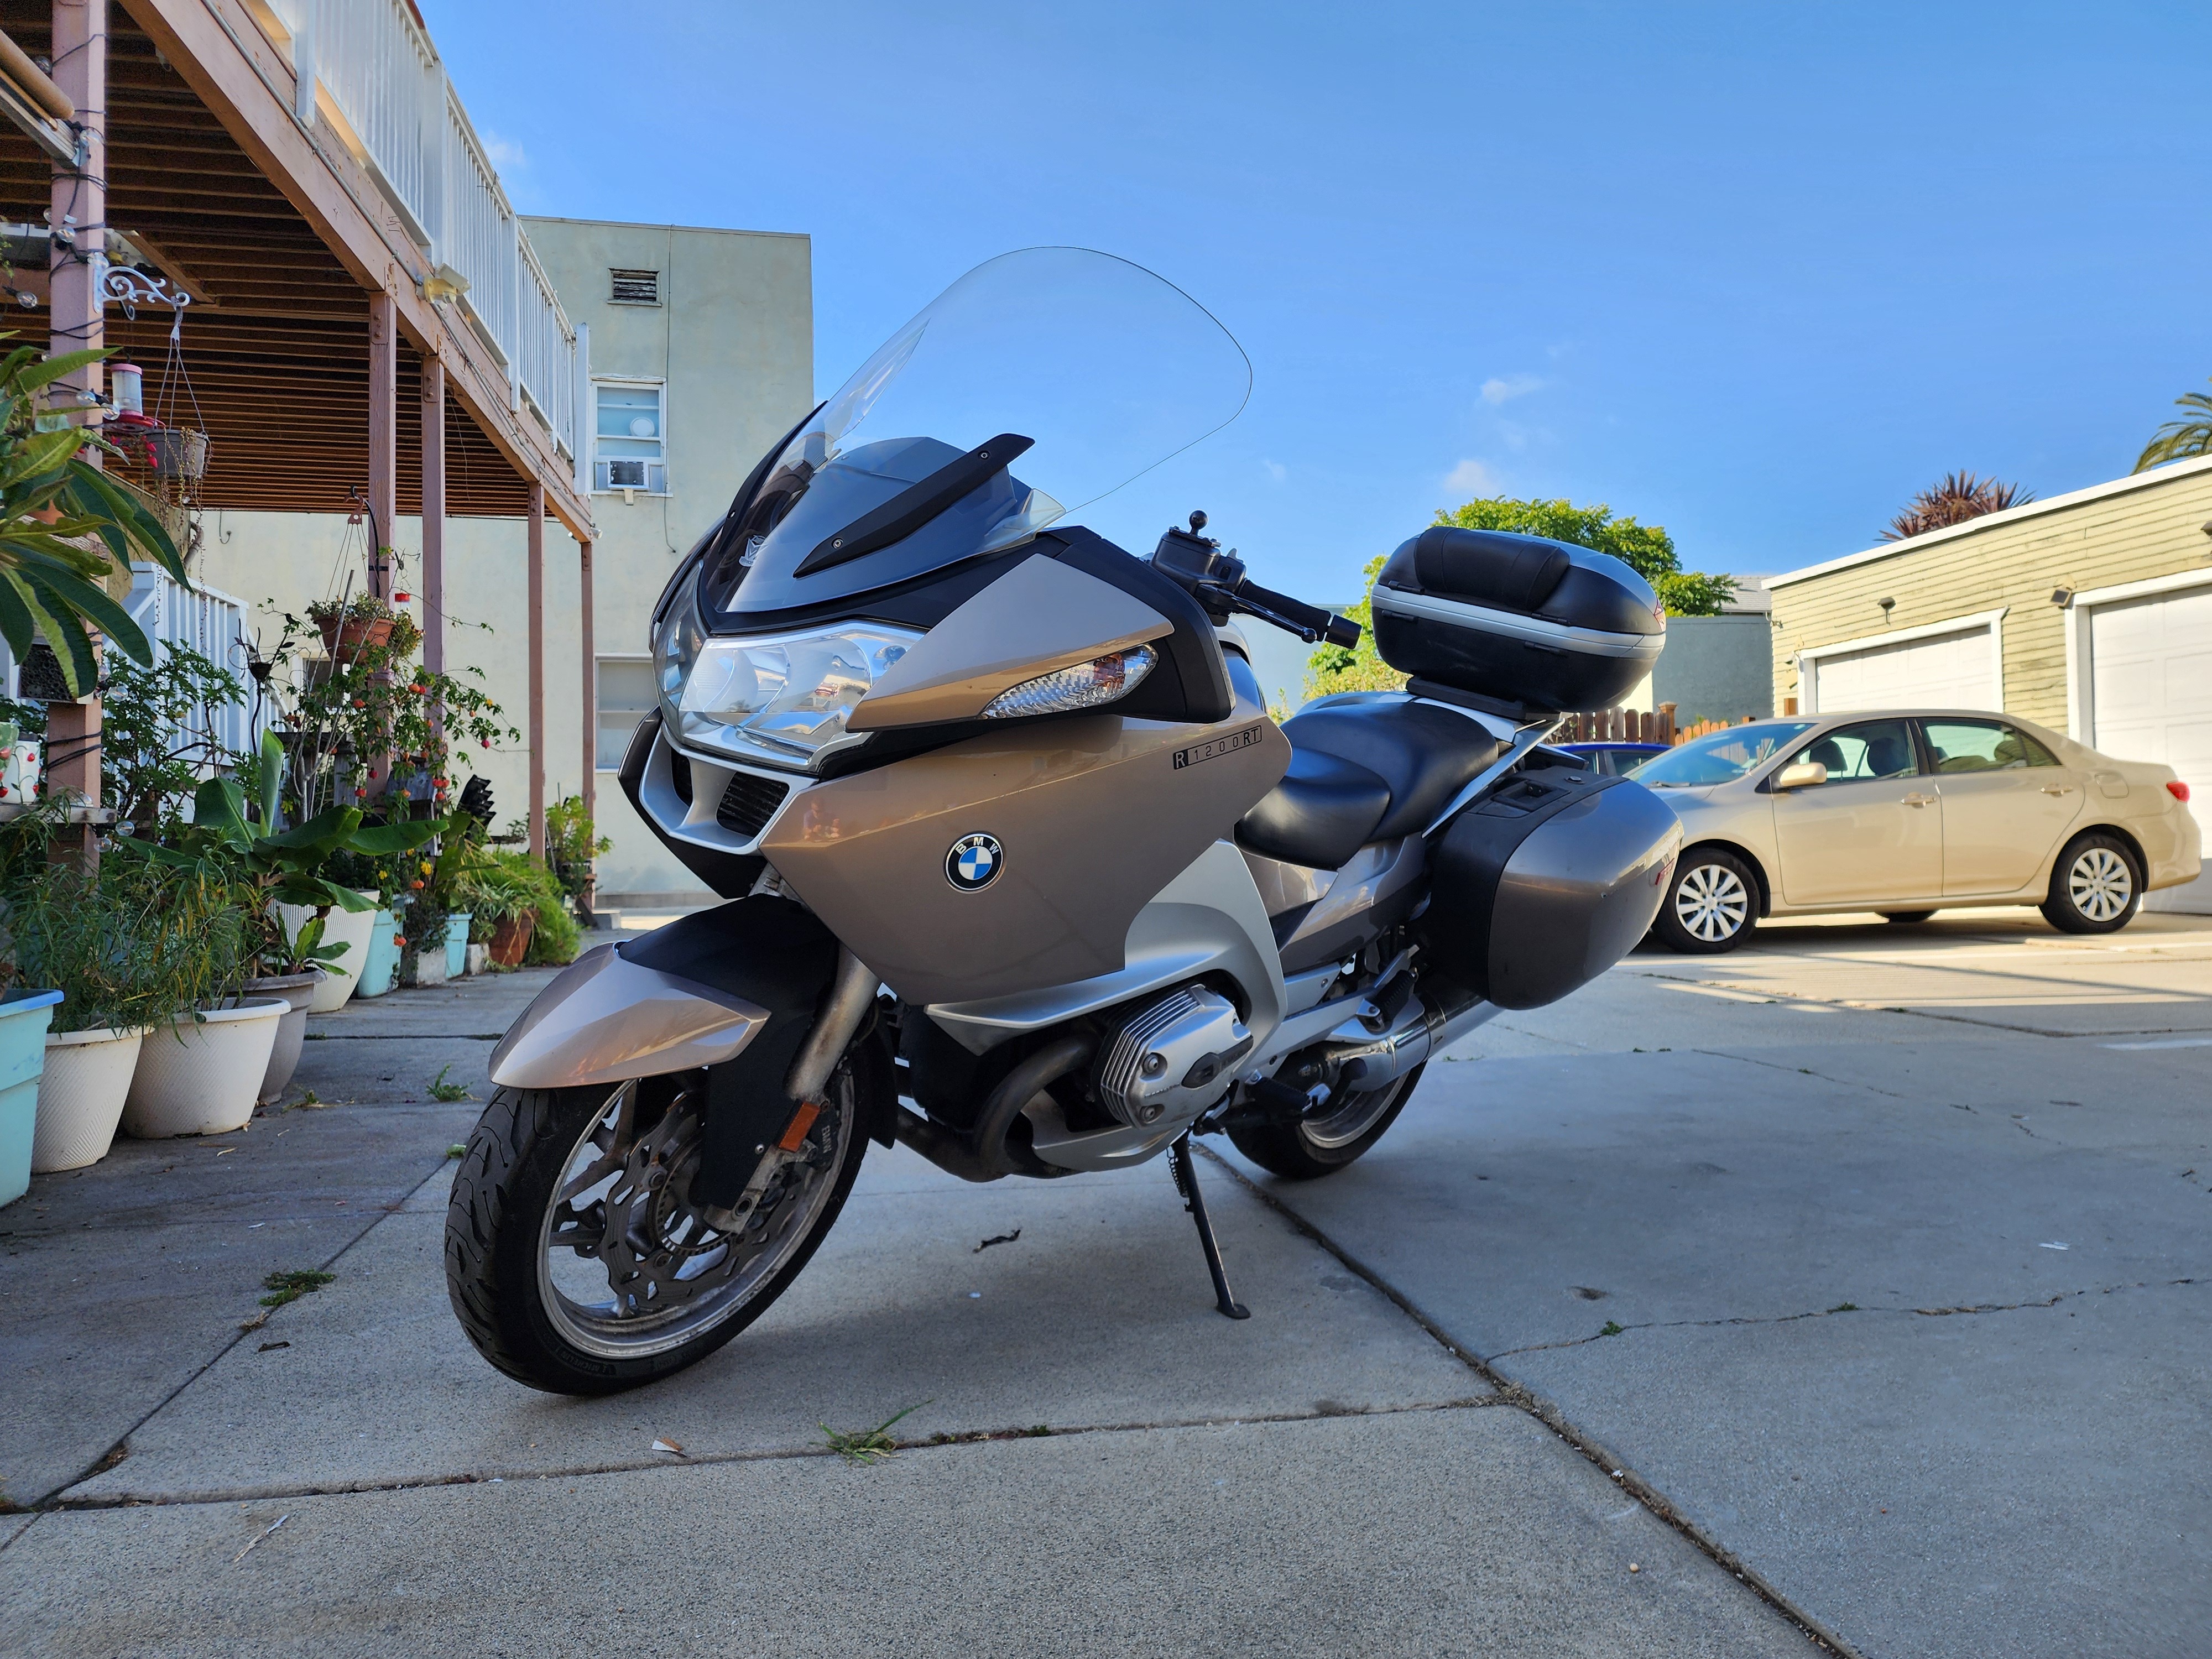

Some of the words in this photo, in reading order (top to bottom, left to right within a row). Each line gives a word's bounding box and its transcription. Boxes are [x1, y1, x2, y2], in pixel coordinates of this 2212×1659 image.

[955, 837, 999, 854] BMW
[821, 1125, 832, 1154] BMW
[560, 1350, 600, 1373] MICHELIN
